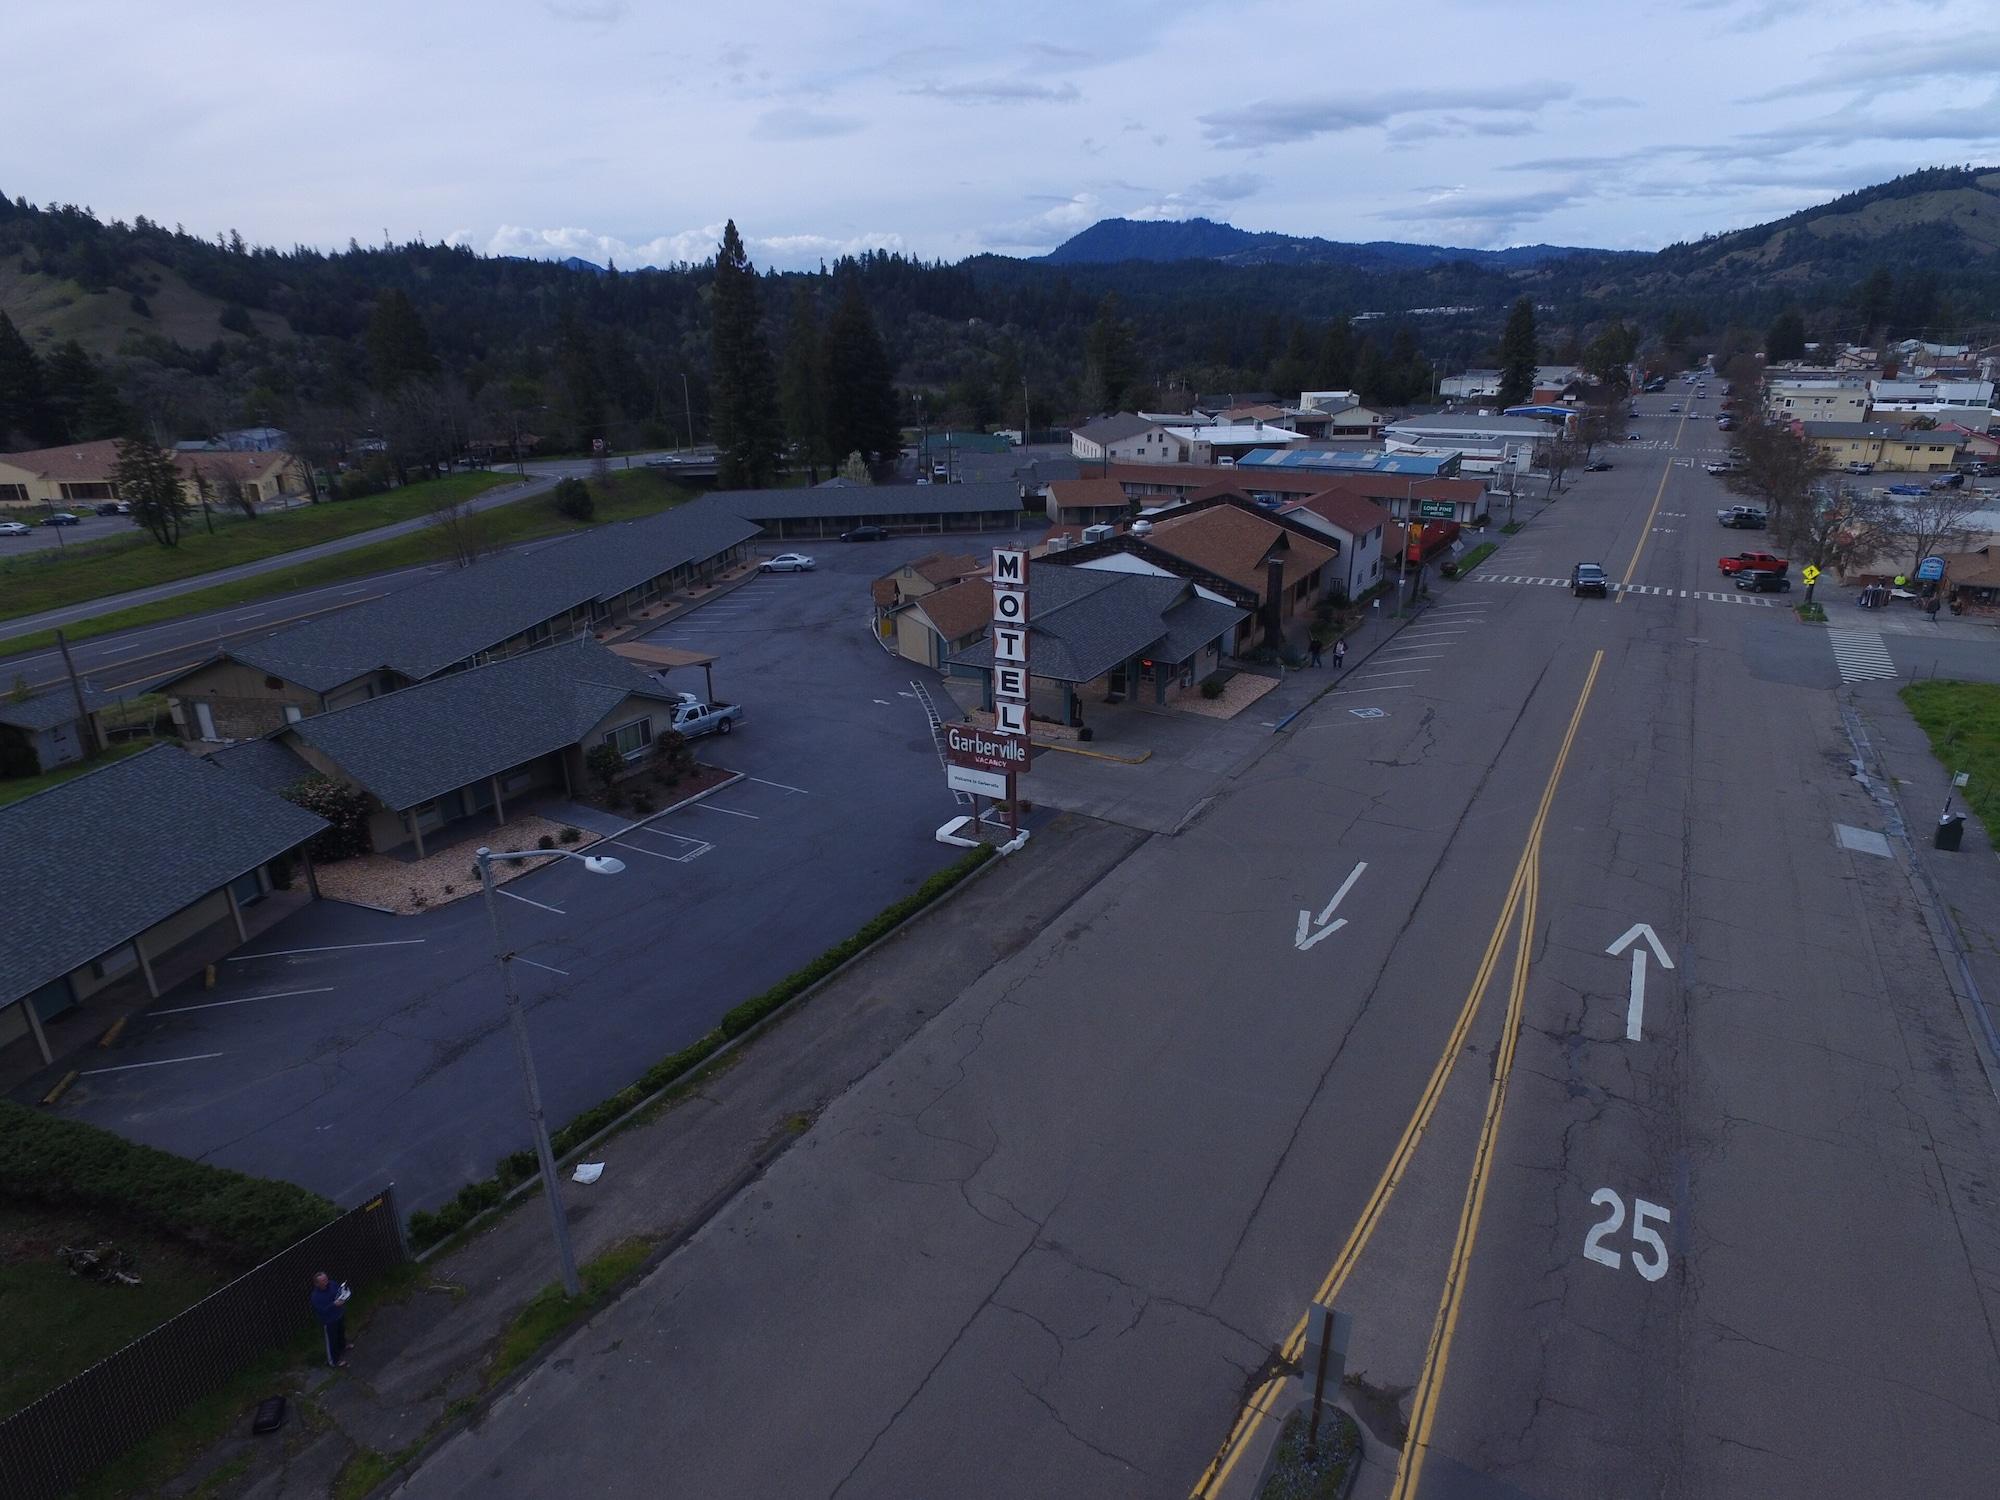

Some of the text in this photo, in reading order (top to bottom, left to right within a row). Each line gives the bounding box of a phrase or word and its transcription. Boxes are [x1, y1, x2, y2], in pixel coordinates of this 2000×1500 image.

[998, 554, 1020, 730] MOTEL
[949, 728, 1025, 761] Garberville
[975, 756, 1007, 768] VACANCY
[954, 775, 971, 783] Welcome
[1584, 1187, 1670, 1282] 25
